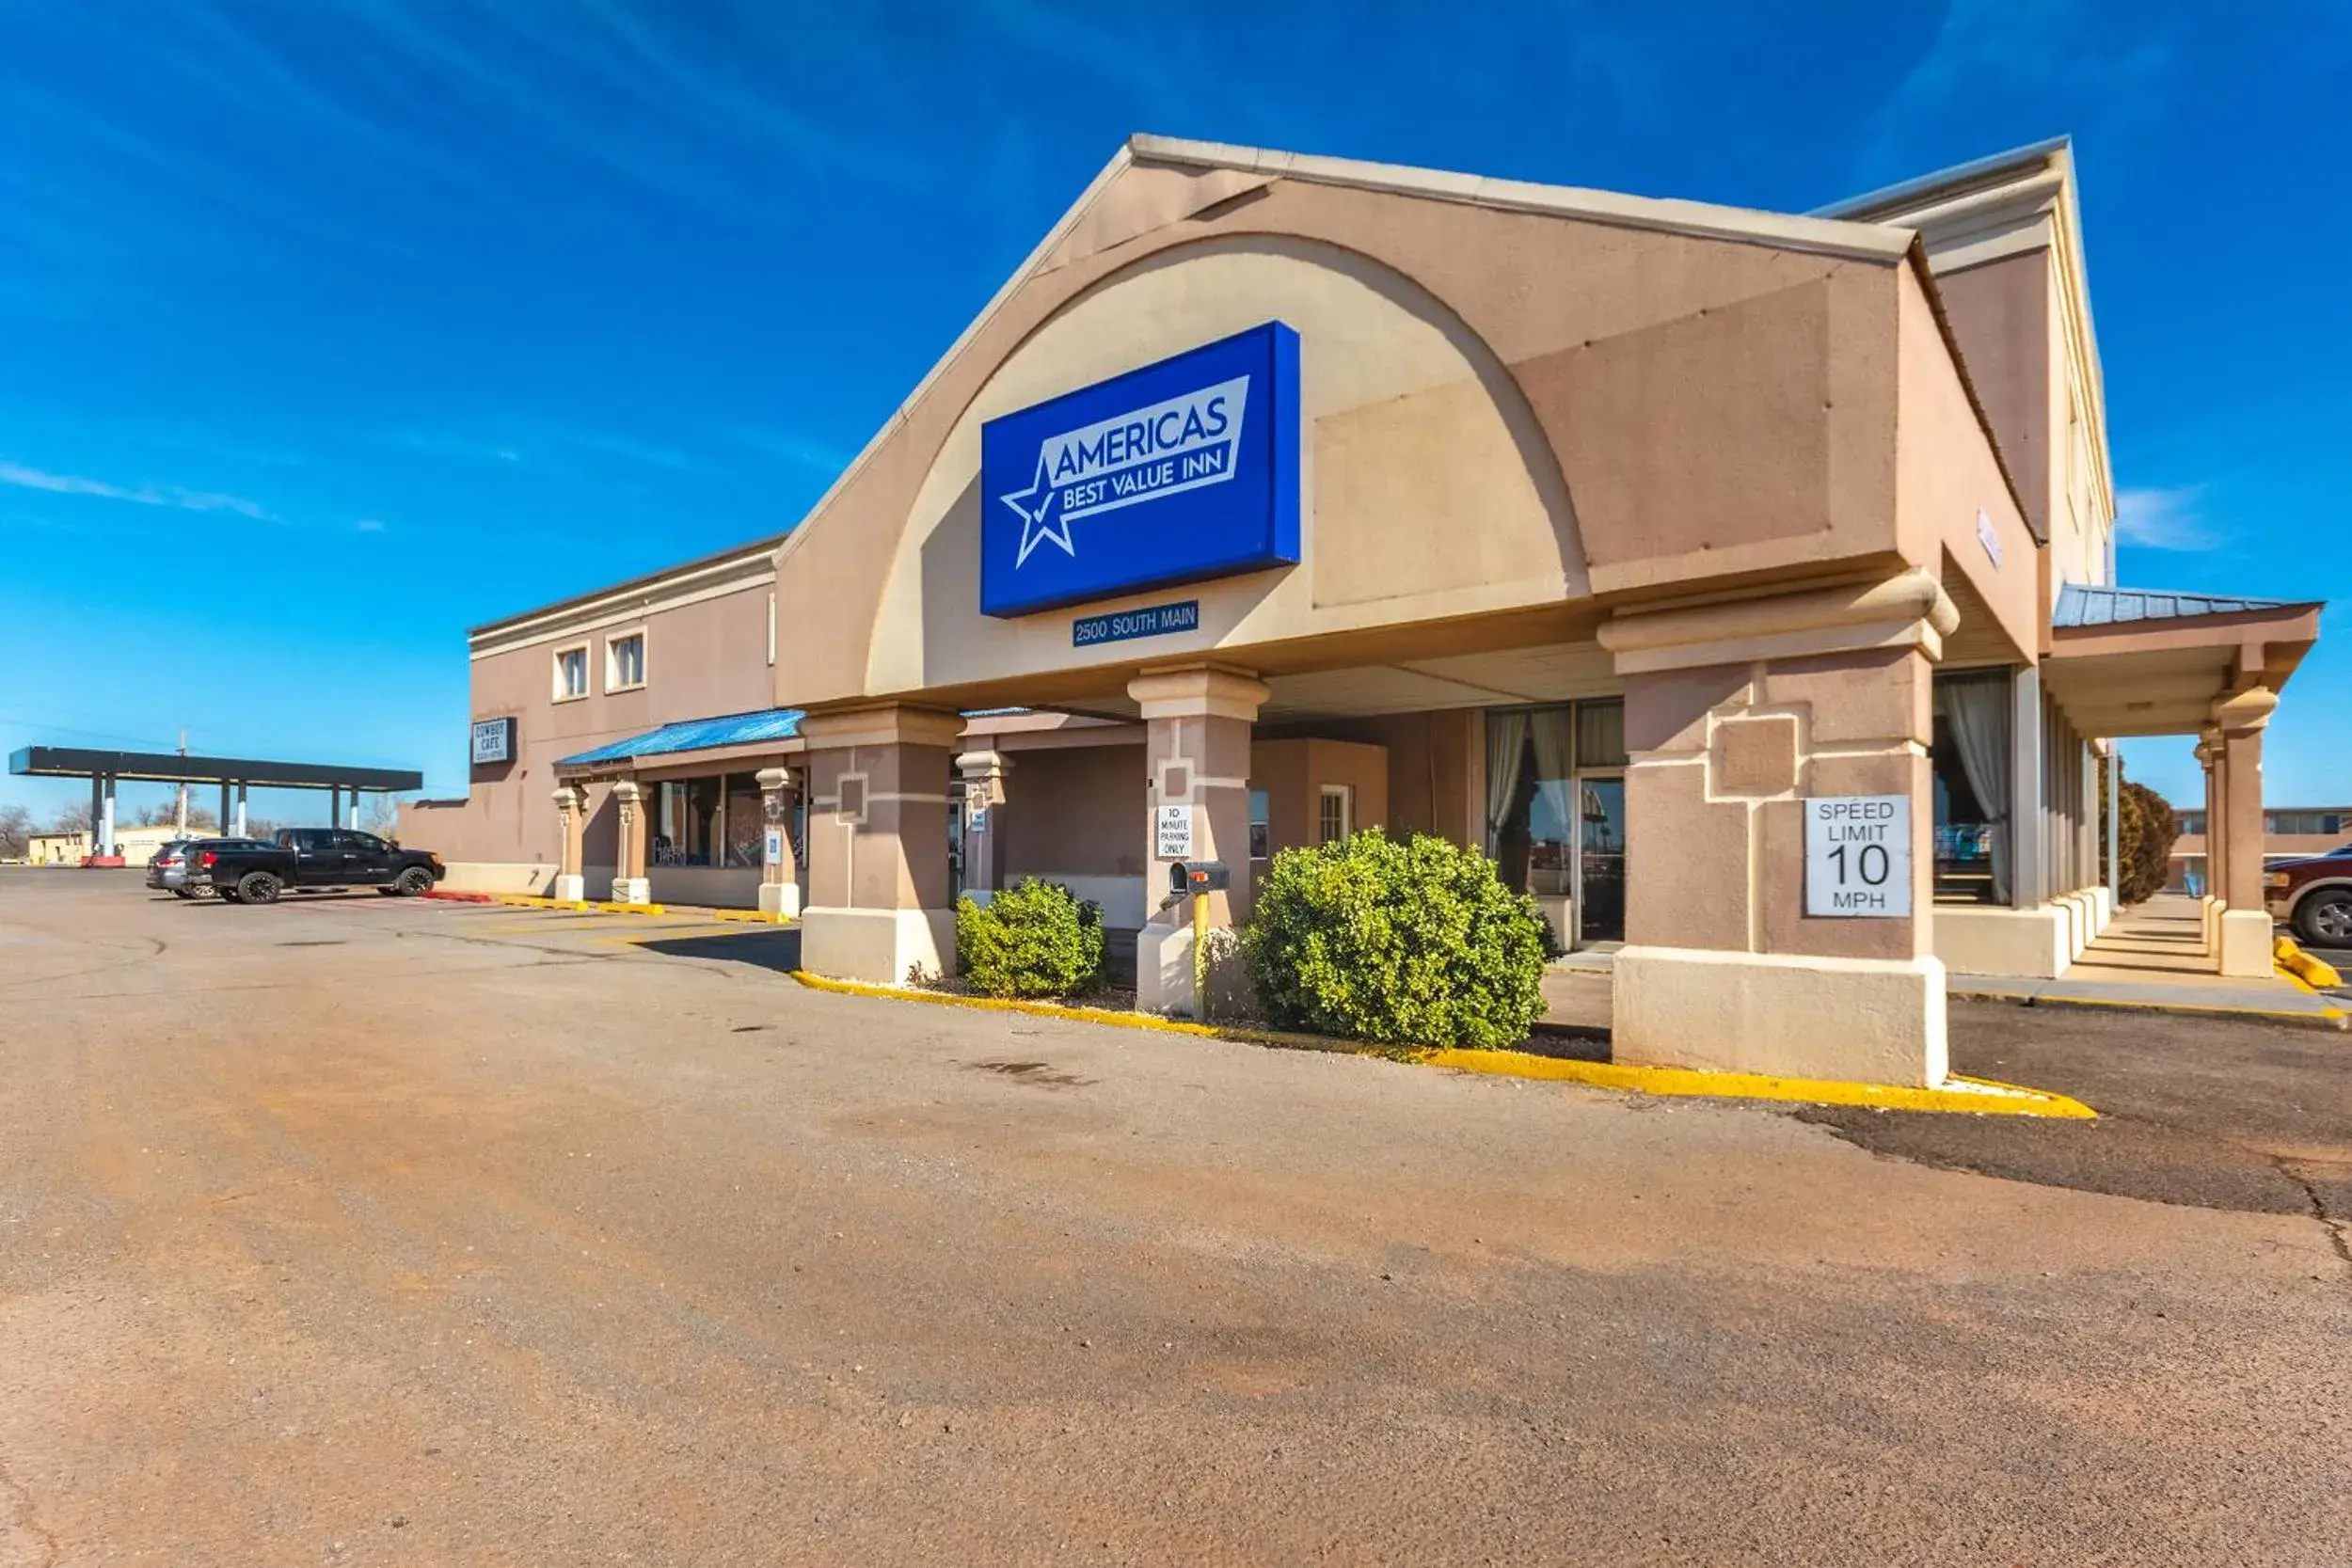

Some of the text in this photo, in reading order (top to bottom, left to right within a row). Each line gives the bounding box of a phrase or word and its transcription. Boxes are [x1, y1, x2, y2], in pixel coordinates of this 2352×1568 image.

[1054, 397, 1229, 481] AMERICAS
[1063, 449, 1222, 510] BEST VALUE INN
[1075, 606, 1196, 642] 2500 SOUTH MAIN
[1168, 808, 1180, 817] 10
[1819, 802, 1895, 820] SPEED
[1161, 820, 1188, 830] MINUTE
[1828, 824, 1889, 842] LIMIT
[1160, 832, 1189, 842] PARKING
[1165, 845, 1185, 854] ONLY
[1827, 844, 1889, 885] 10
[1833, 892, 1885, 909] MPH
